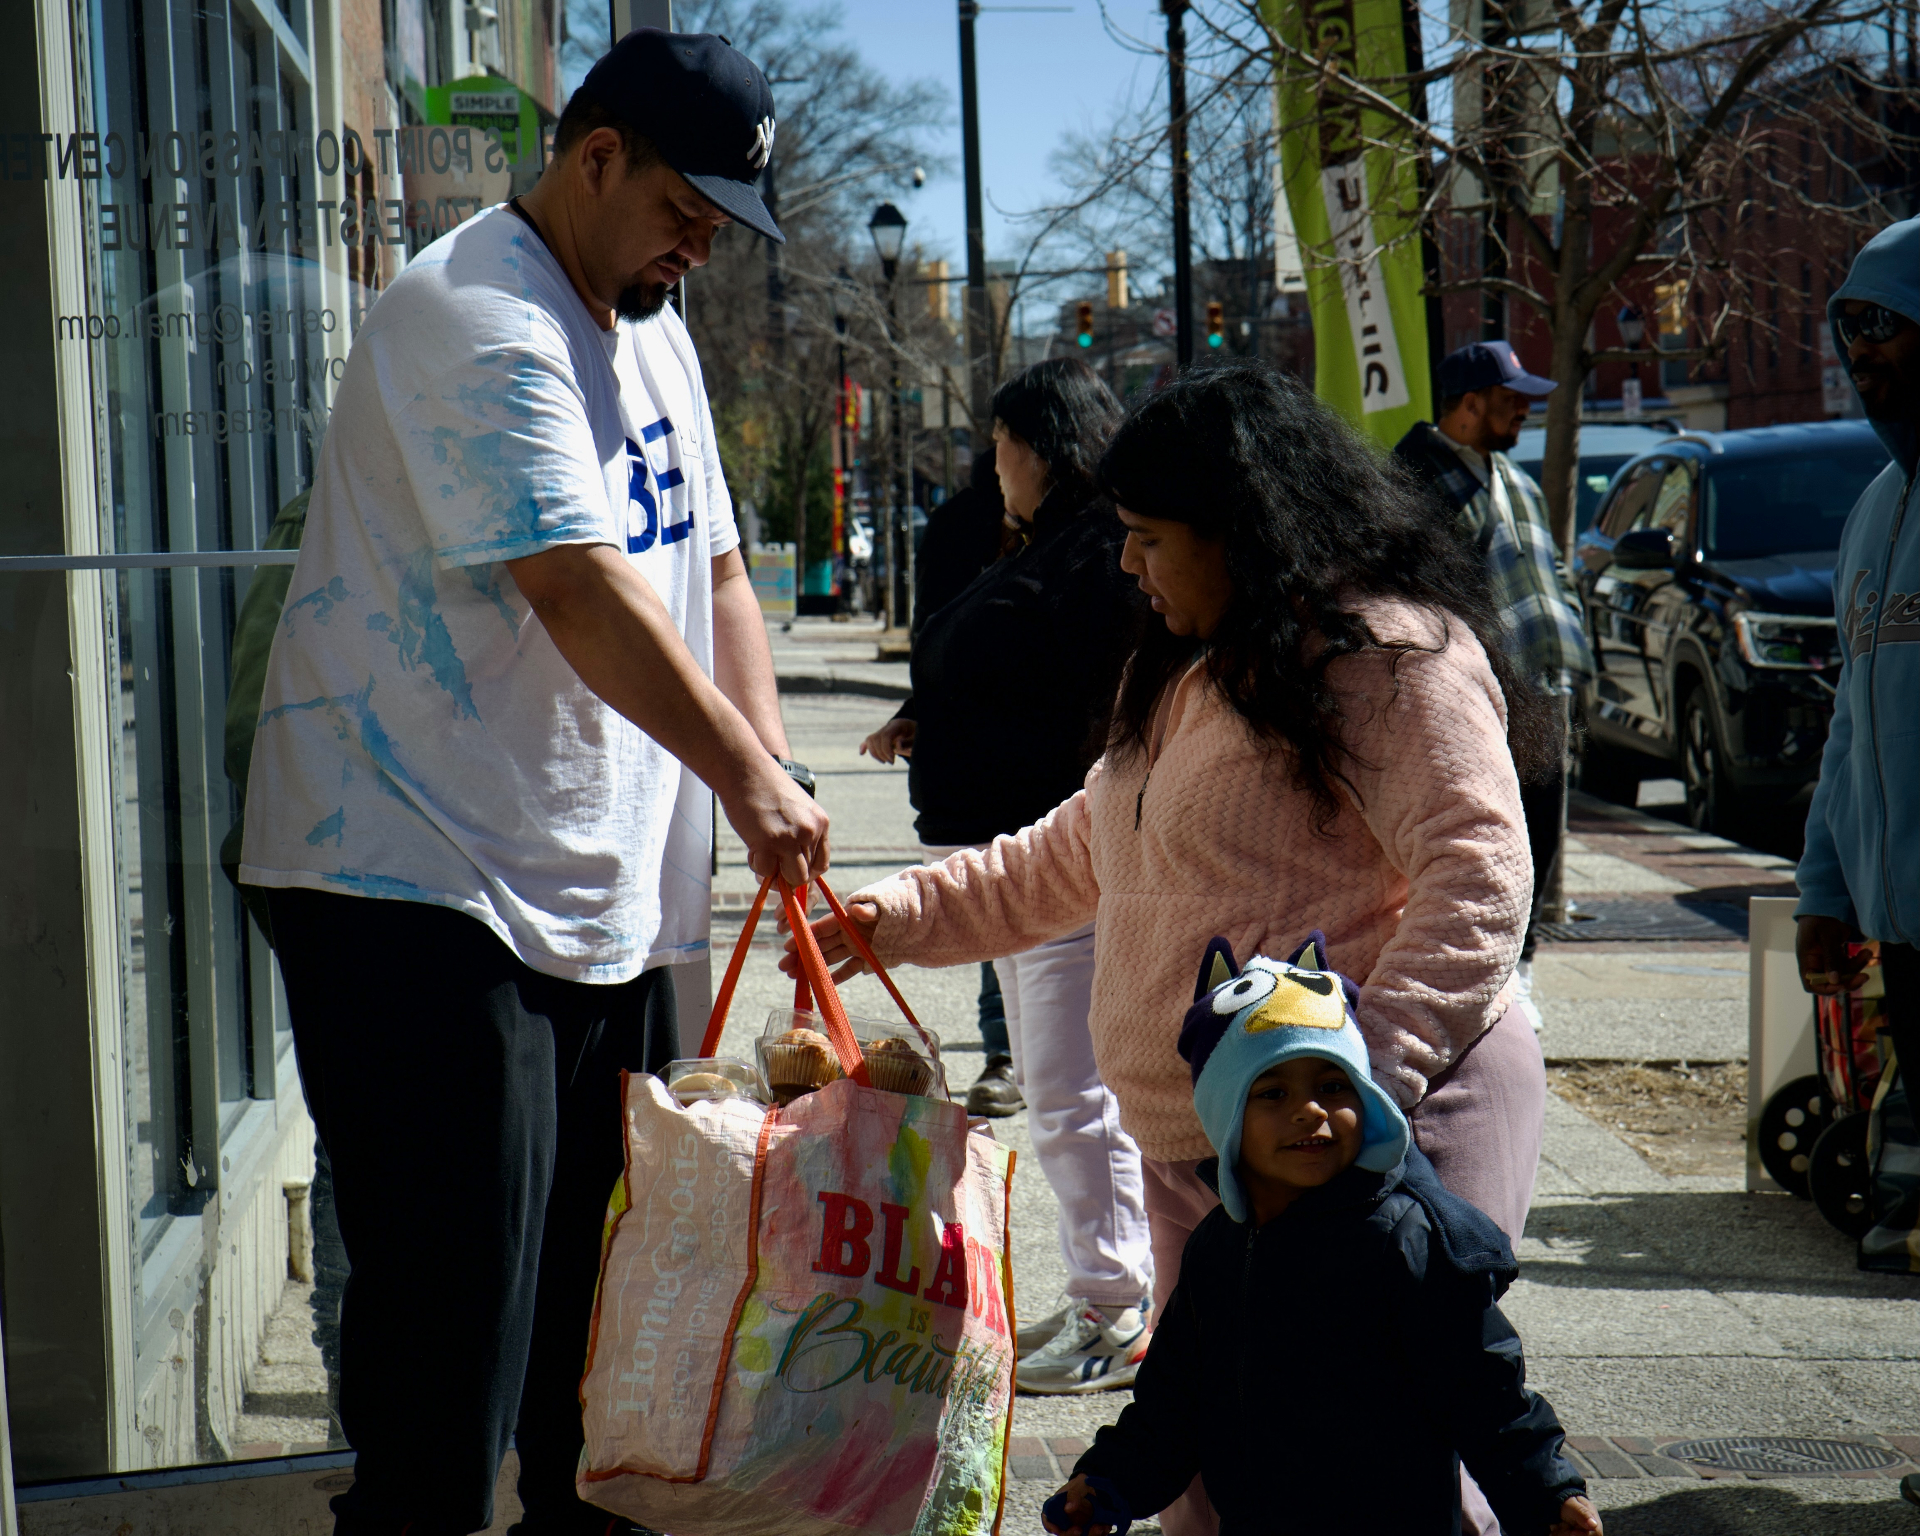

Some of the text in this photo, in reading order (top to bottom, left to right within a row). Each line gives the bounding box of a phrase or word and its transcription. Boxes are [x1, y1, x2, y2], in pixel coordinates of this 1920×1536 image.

[453, 95, 516, 111] SIMPLE
[614, 1132, 700, 1420] HomeGoods
[666, 1128, 732, 1421] SHOP HOMEGOODS.CO
[906, 1306, 931, 1335] IS
